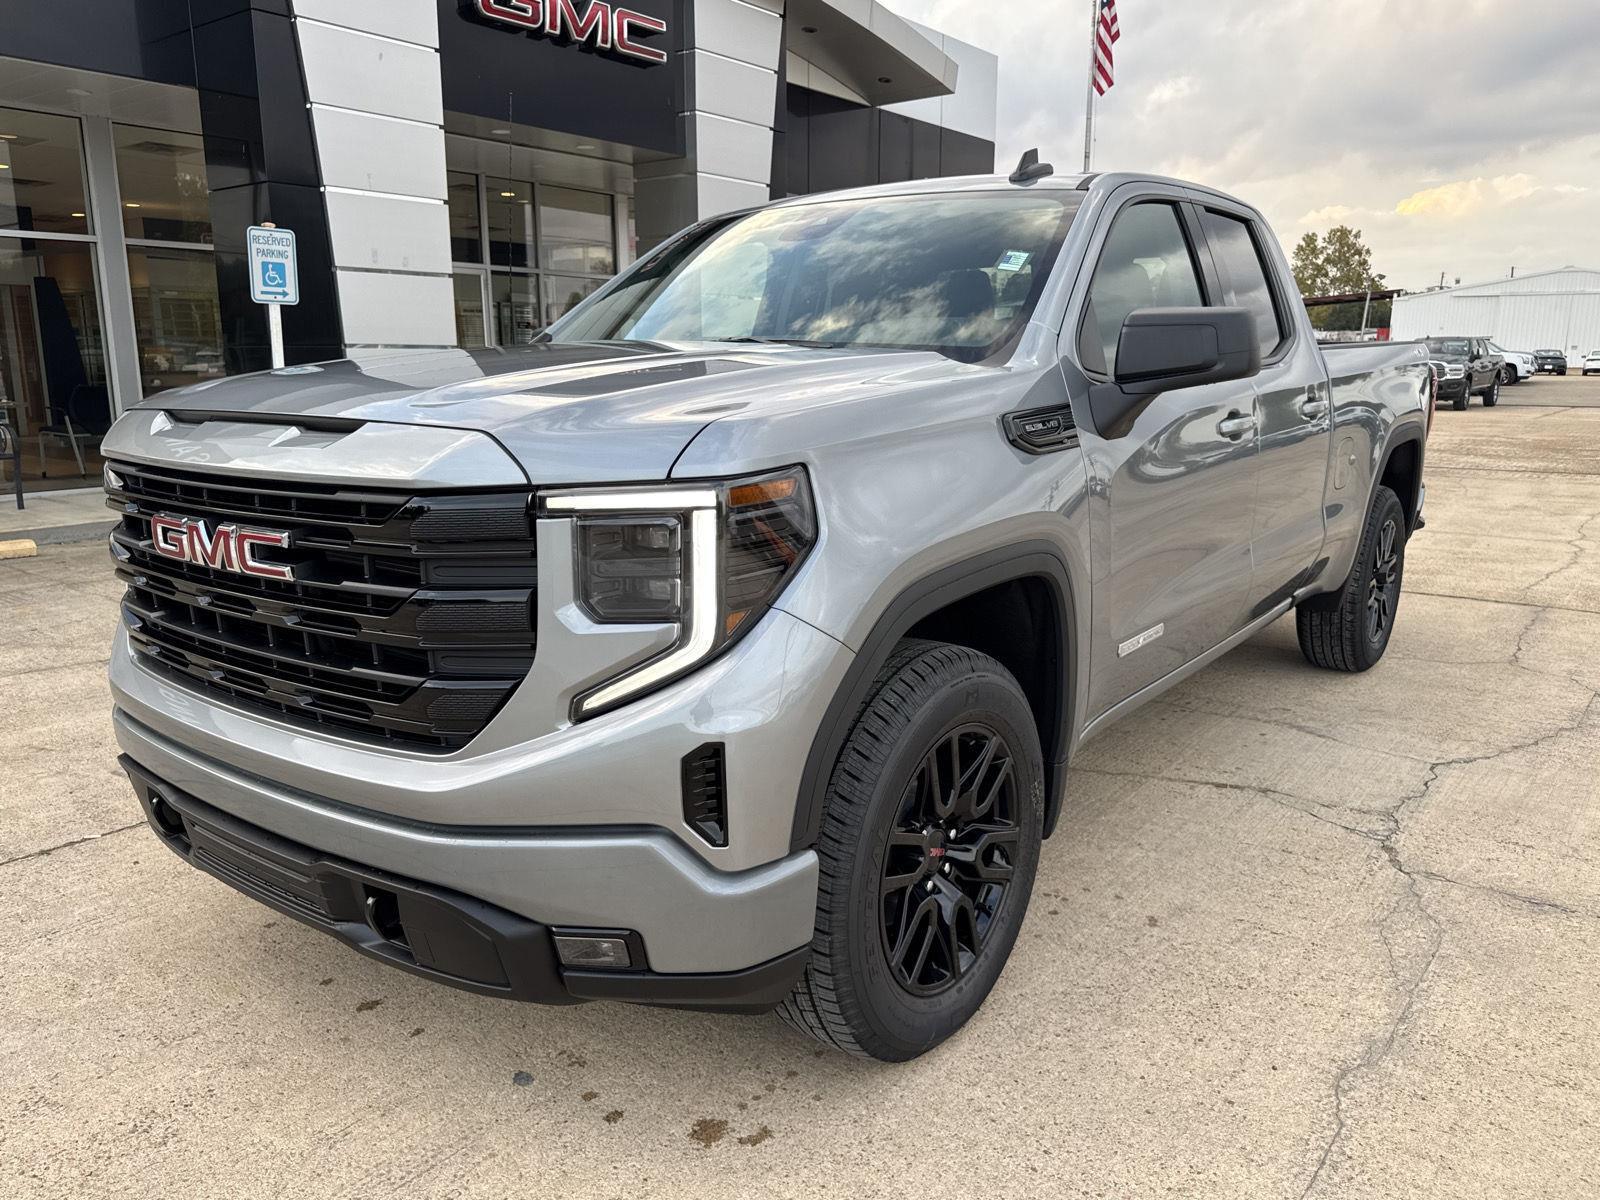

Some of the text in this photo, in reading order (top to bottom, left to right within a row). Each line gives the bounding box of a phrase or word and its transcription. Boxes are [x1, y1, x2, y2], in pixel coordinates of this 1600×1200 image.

[252, 235, 291, 247] RESERVED
[256, 248, 289, 259] PARKING
[151, 513, 295, 582] GMC
